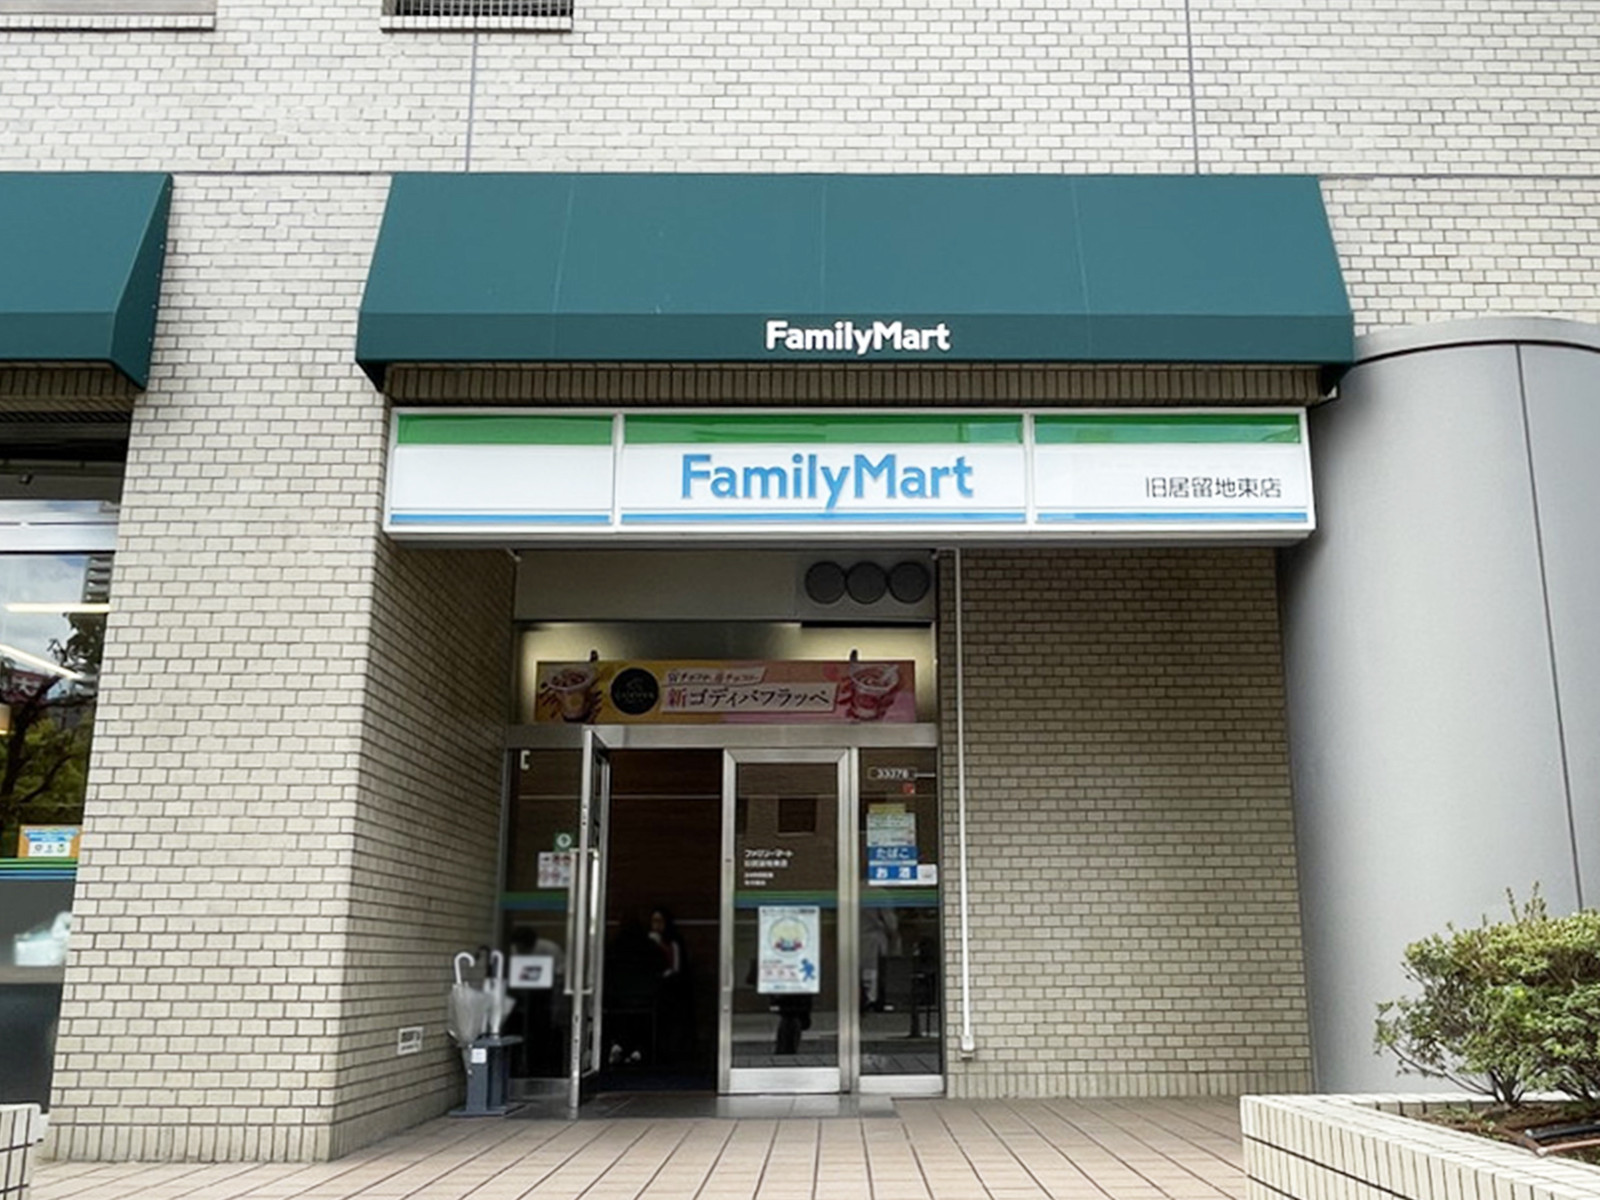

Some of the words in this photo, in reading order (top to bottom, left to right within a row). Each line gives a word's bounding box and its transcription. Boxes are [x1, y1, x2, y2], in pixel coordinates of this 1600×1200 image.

[766, 320, 950, 355] FamilyMart
[681, 453, 974, 512] FamilyMart
[1145, 476, 1282, 498] 旧居留地東店
